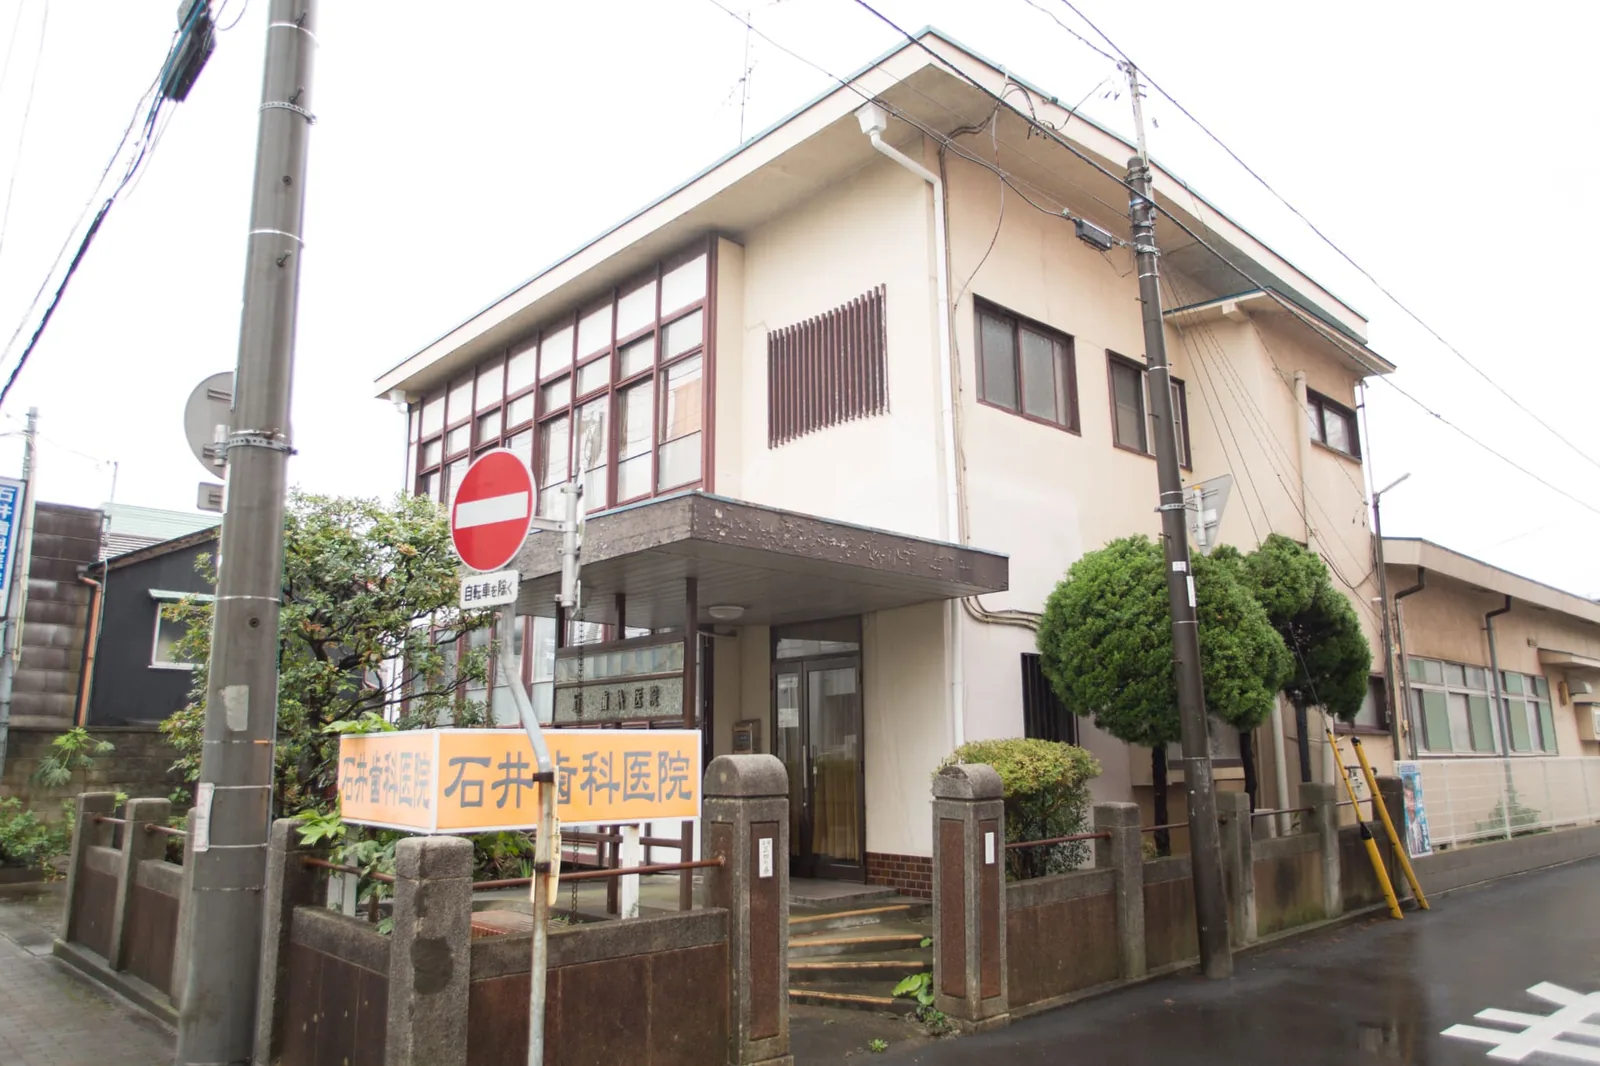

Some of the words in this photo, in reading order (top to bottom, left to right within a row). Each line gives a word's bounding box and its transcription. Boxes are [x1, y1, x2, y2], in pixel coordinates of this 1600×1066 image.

[464, 579, 513, 602] 自転車を除く
[341, 750, 431, 810] 石井歯科医院
[444, 749, 693, 809] 石井歯科医院
